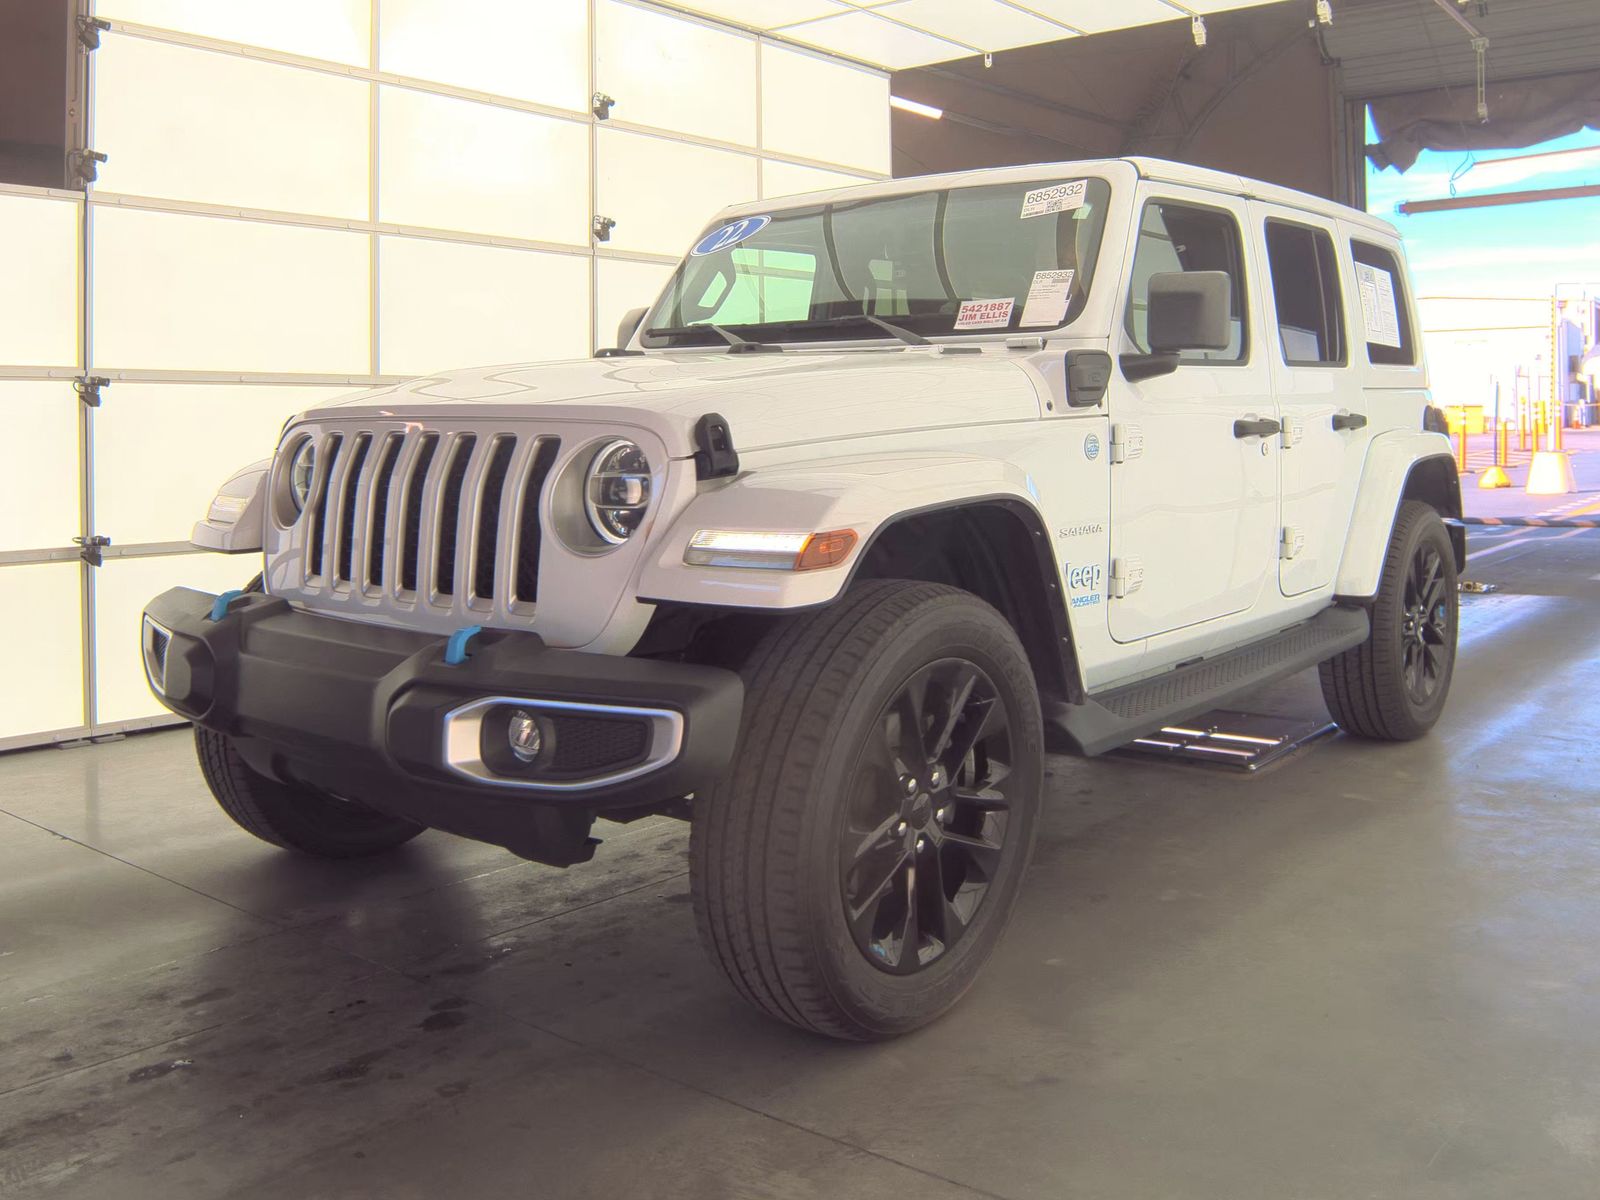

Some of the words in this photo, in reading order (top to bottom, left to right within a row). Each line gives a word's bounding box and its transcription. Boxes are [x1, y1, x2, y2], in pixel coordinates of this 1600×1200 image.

[1027, 184, 1083, 204] 6852932
[708, 220, 750, 252] 22
[1036, 271, 1073, 280] 6852932
[961, 302, 1012, 313] 5421887
[958, 313, 977, 321] JIM
[980, 311, 1009, 320] ELLIS
[1071, 594, 1100, 605] ANGLER
